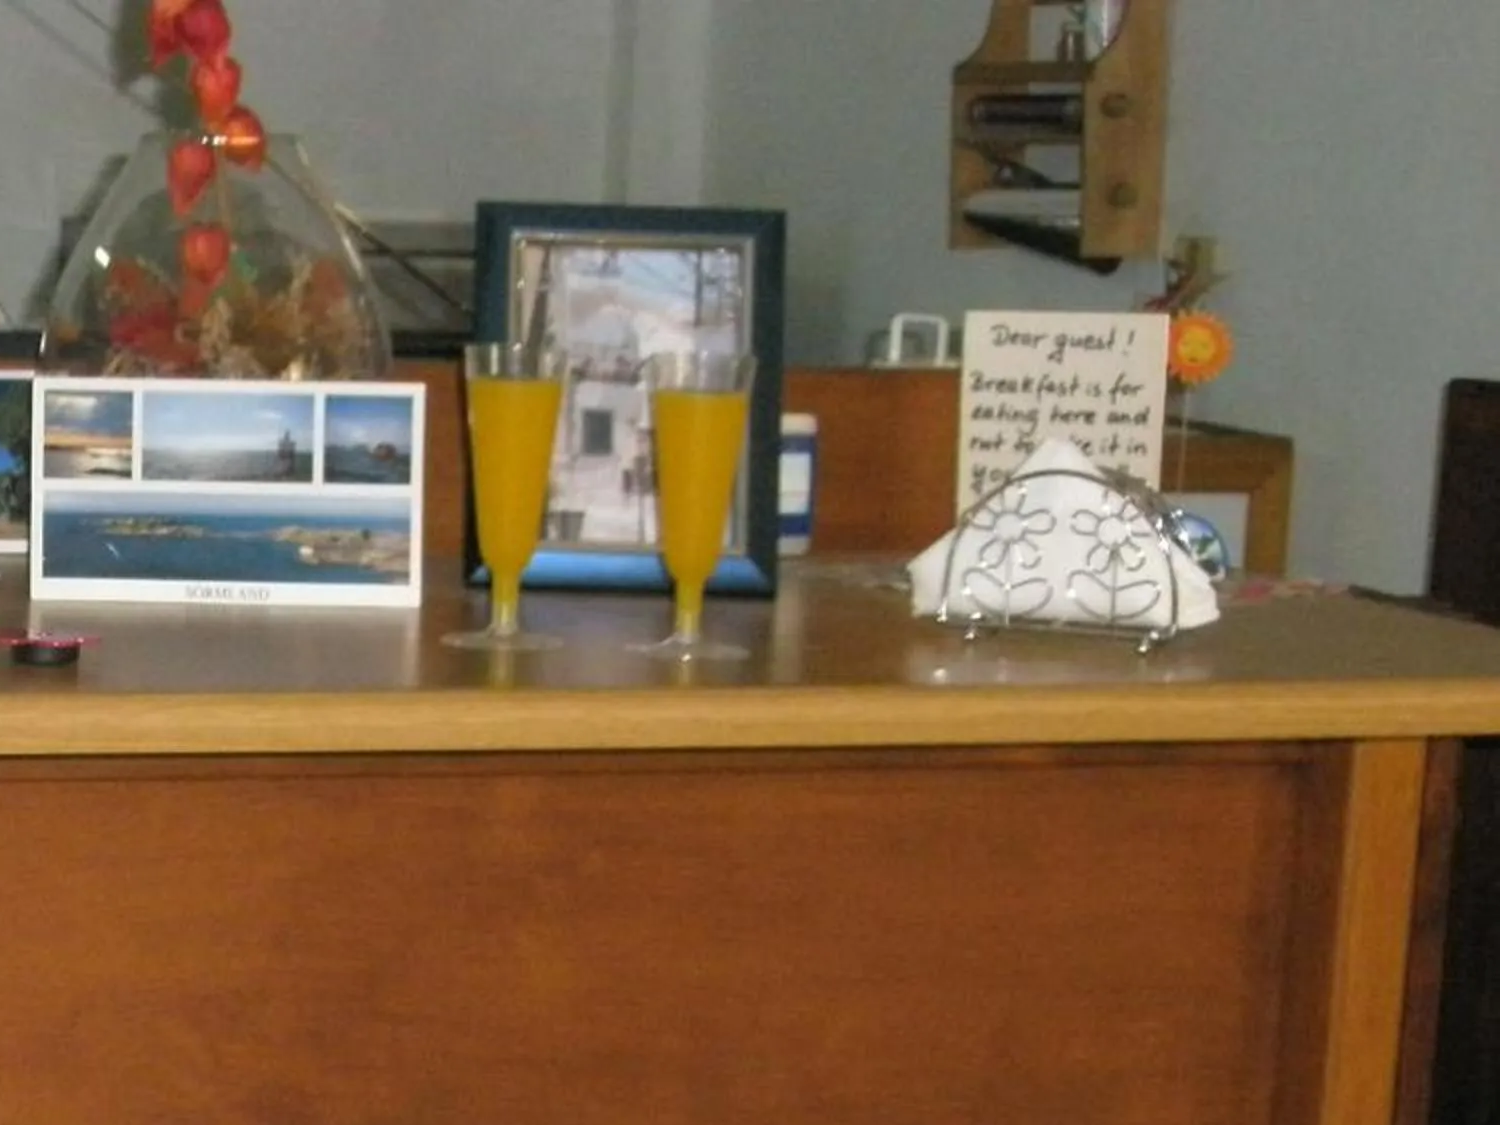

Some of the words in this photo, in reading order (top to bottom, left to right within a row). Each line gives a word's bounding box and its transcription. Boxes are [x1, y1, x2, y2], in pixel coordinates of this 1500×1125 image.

[990, 325, 1047, 348] Dear
[970, 371, 1079, 400] Breakfast
[1086, 380, 1102, 397] is
[1108, 372, 1145, 404] for
[971, 403, 1039, 437] eating
[1050, 404, 1097, 425] here
[1106, 407, 1151, 425] and
[970, 433, 1004, 451] not
[1100, 433, 1120, 454] it
[1126, 437, 1148, 456] in
